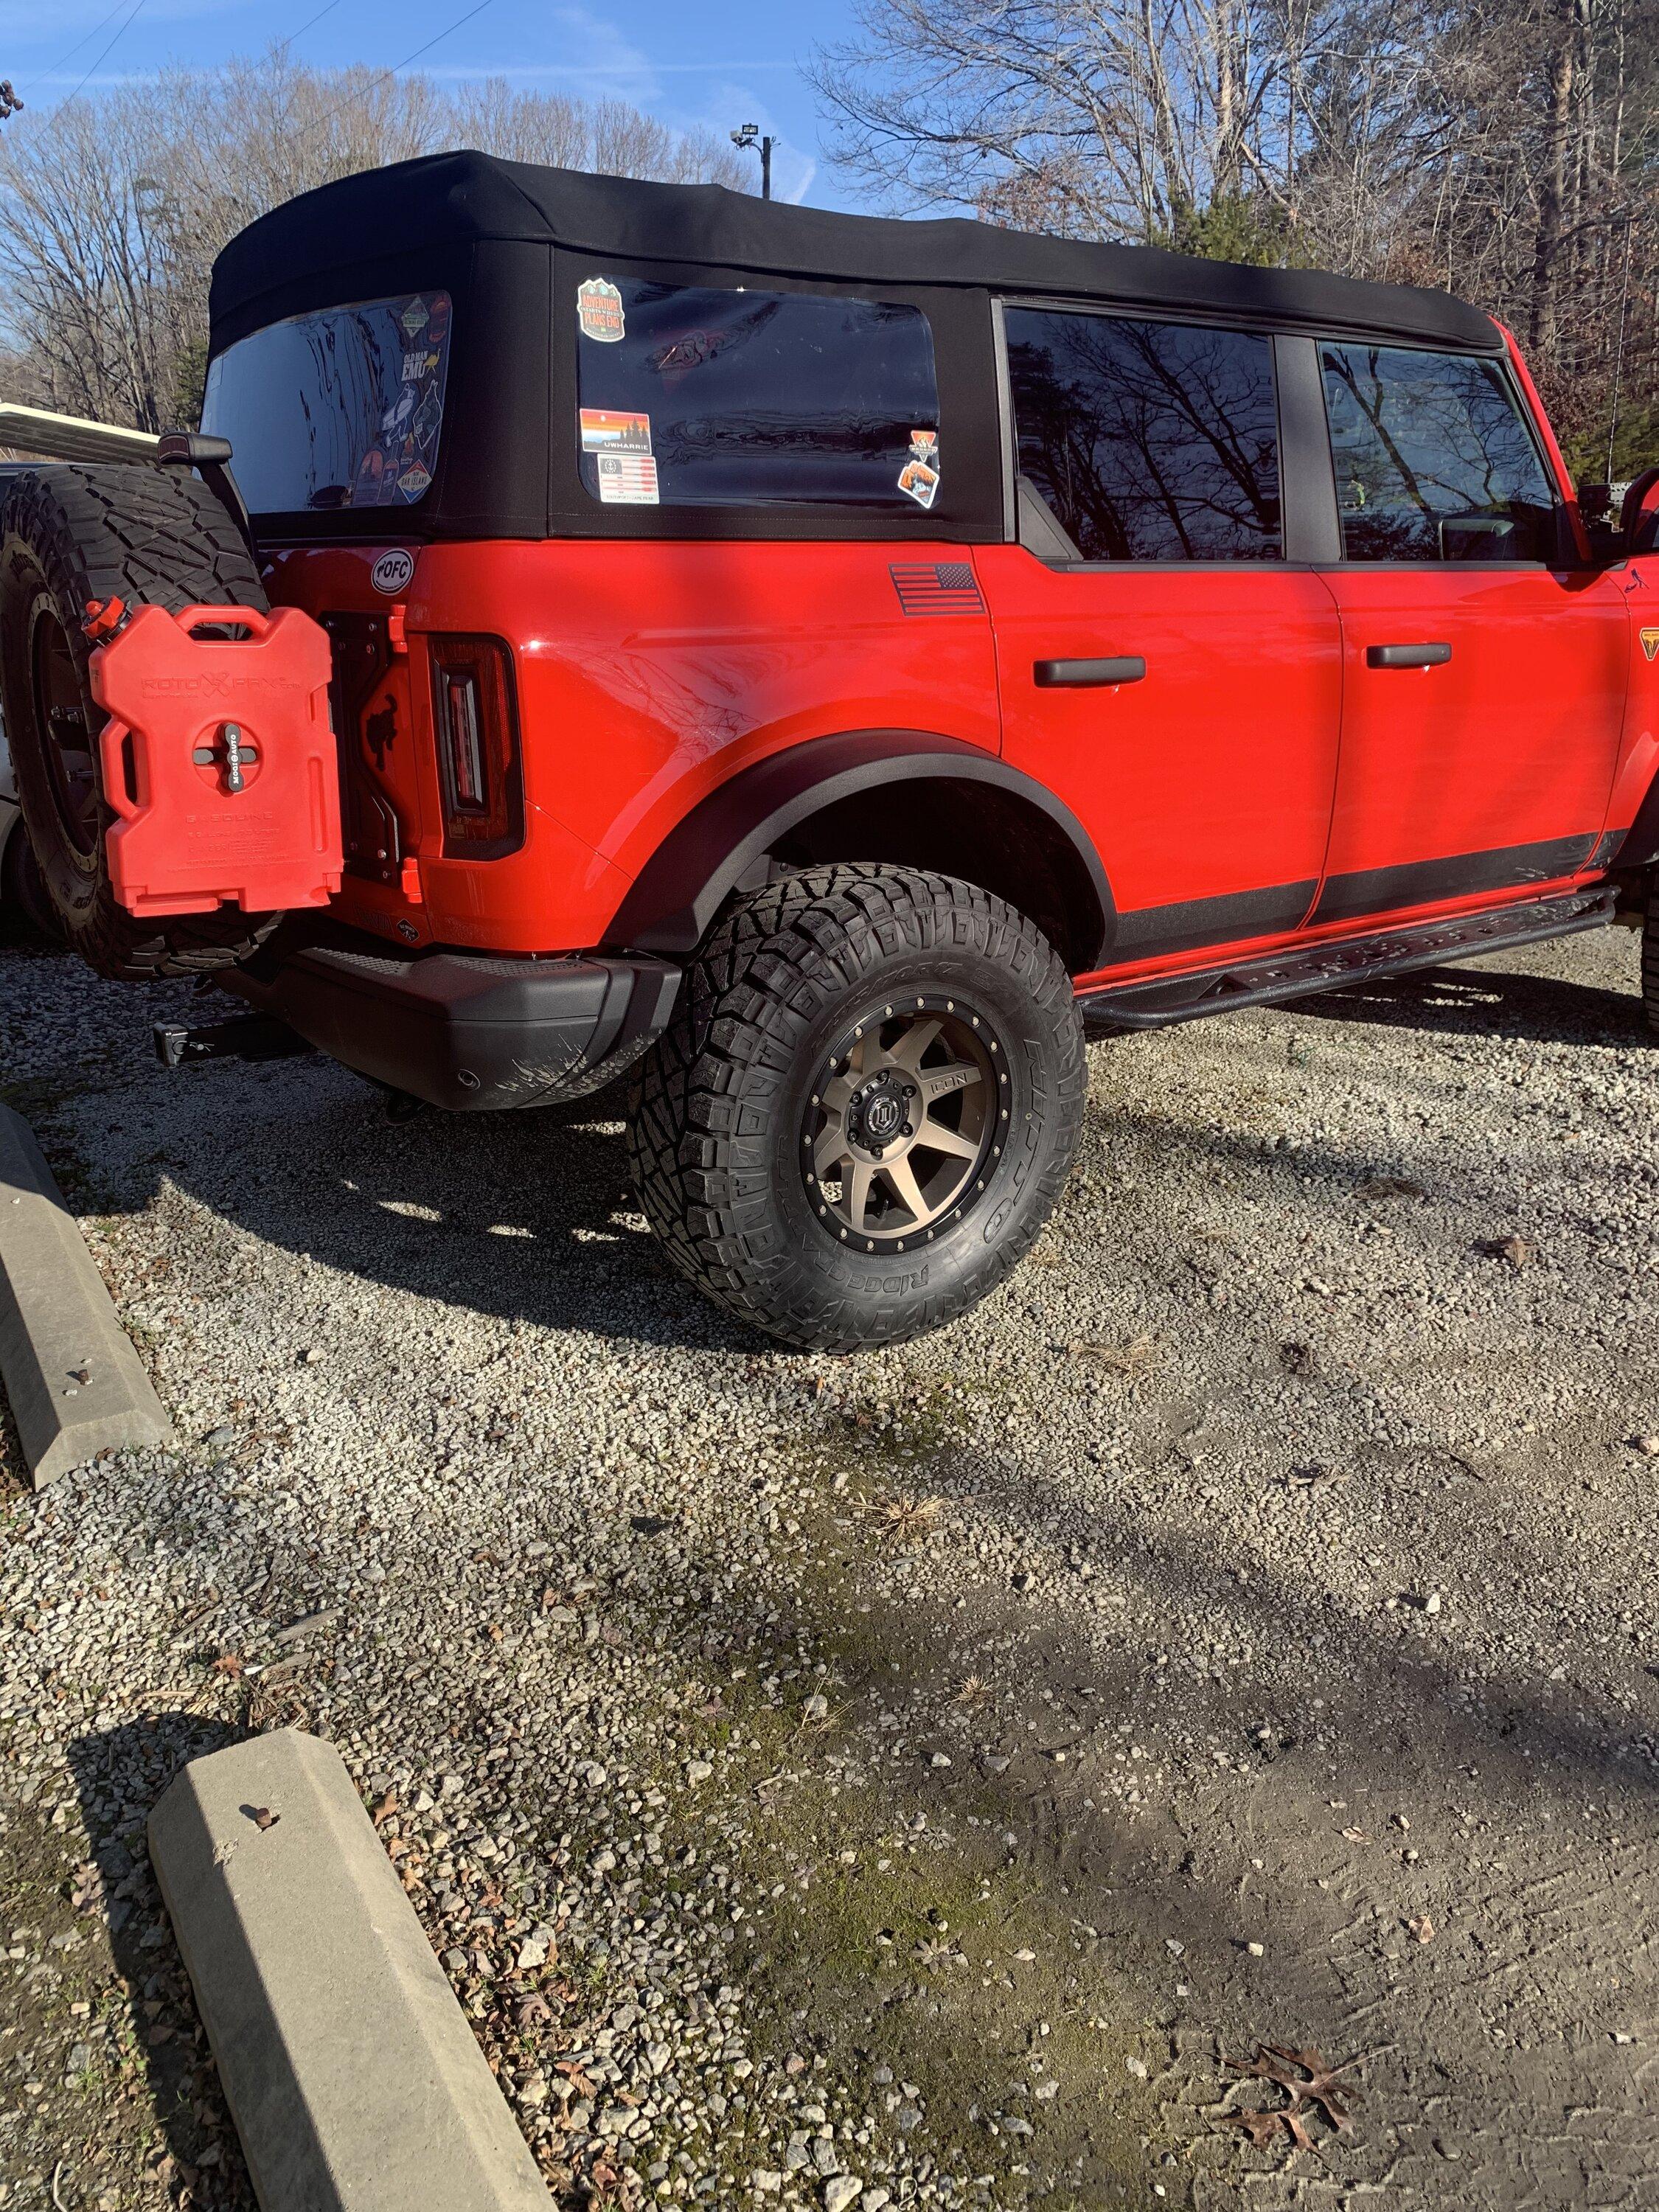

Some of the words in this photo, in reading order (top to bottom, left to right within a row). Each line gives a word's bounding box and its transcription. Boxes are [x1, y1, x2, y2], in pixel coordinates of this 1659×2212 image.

[583, 295, 619, 311] ADVENTURE
[585, 313, 605, 326] PLANS
[607, 316, 619, 328] END
[404, 353, 415, 364] OLD
[415, 351, 428, 362] MAN
[401, 360, 426, 381] EMU
[604, 442, 649, 451] UWHARRIE
[383, 560, 408, 579] OFC
[186, 812, 273, 824] GSOLINE
[930, 1072, 968, 1095] ICON
[983, 1038, 1046, 1245] NITTO
[846, 1264, 931, 1296] RIDGE
